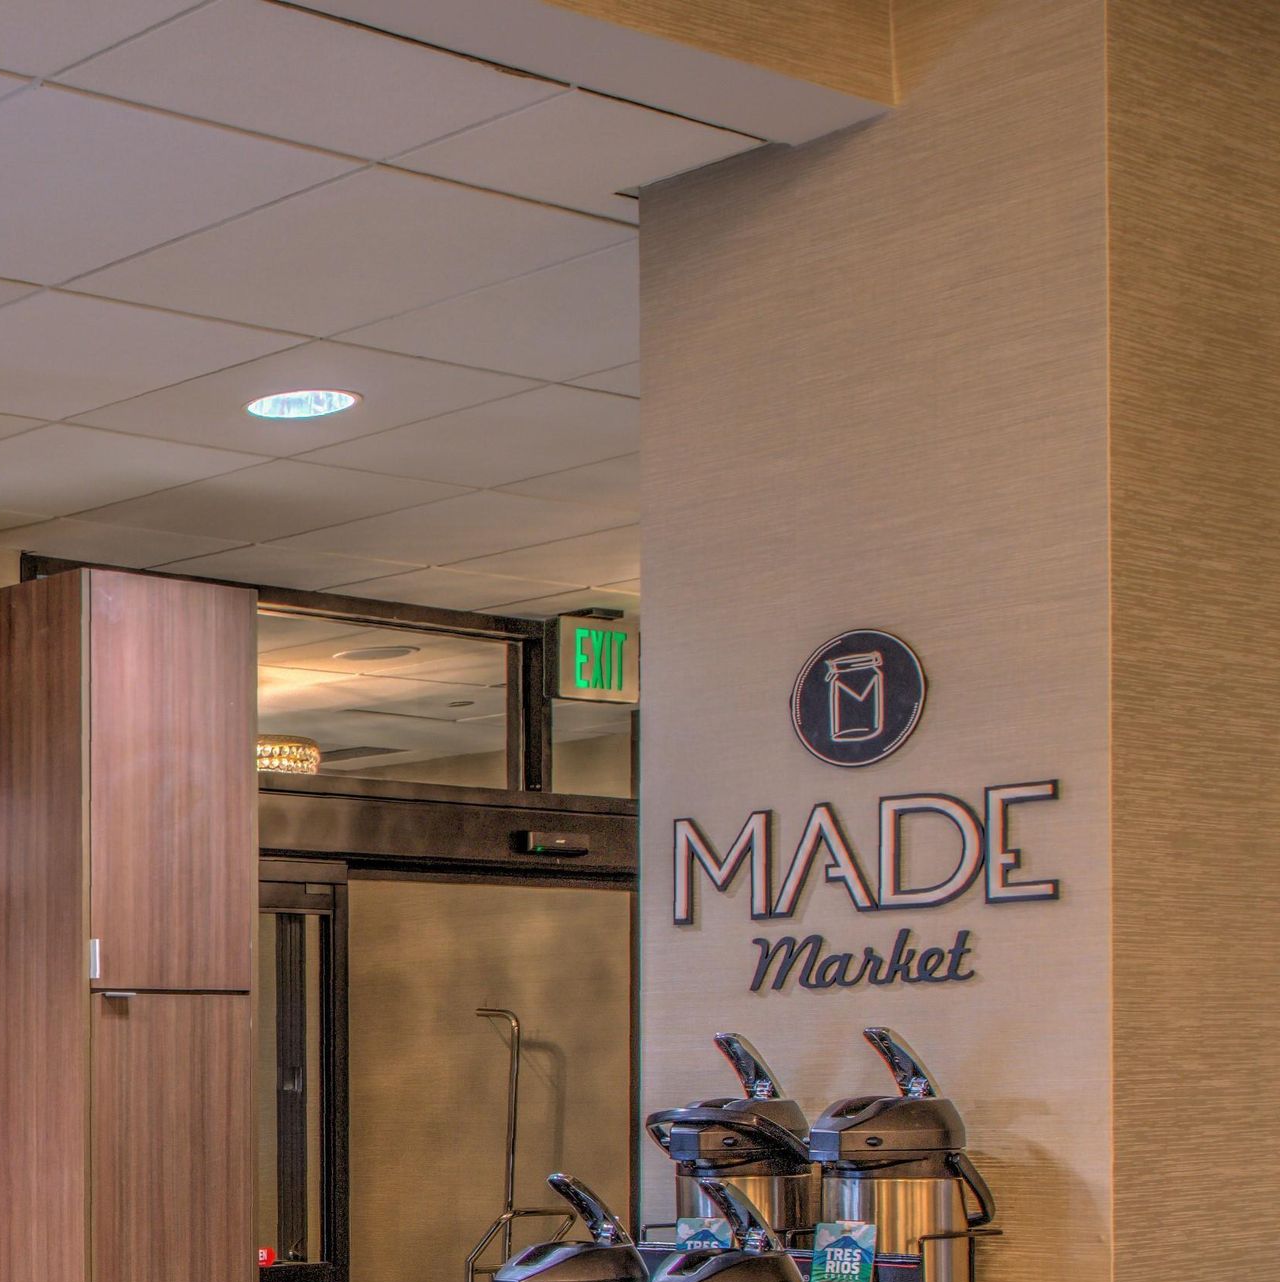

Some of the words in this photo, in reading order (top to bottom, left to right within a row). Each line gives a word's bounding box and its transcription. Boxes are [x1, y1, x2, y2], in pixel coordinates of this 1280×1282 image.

[575, 628, 627, 691] EXIT
[673, 778, 1059, 926] MADE
[749, 927, 975, 992] Market
[258, 1249, 268, 1260] EN
[825, 1248, 861, 1262] TRES
[825, 1260, 860, 1274] RIOS
